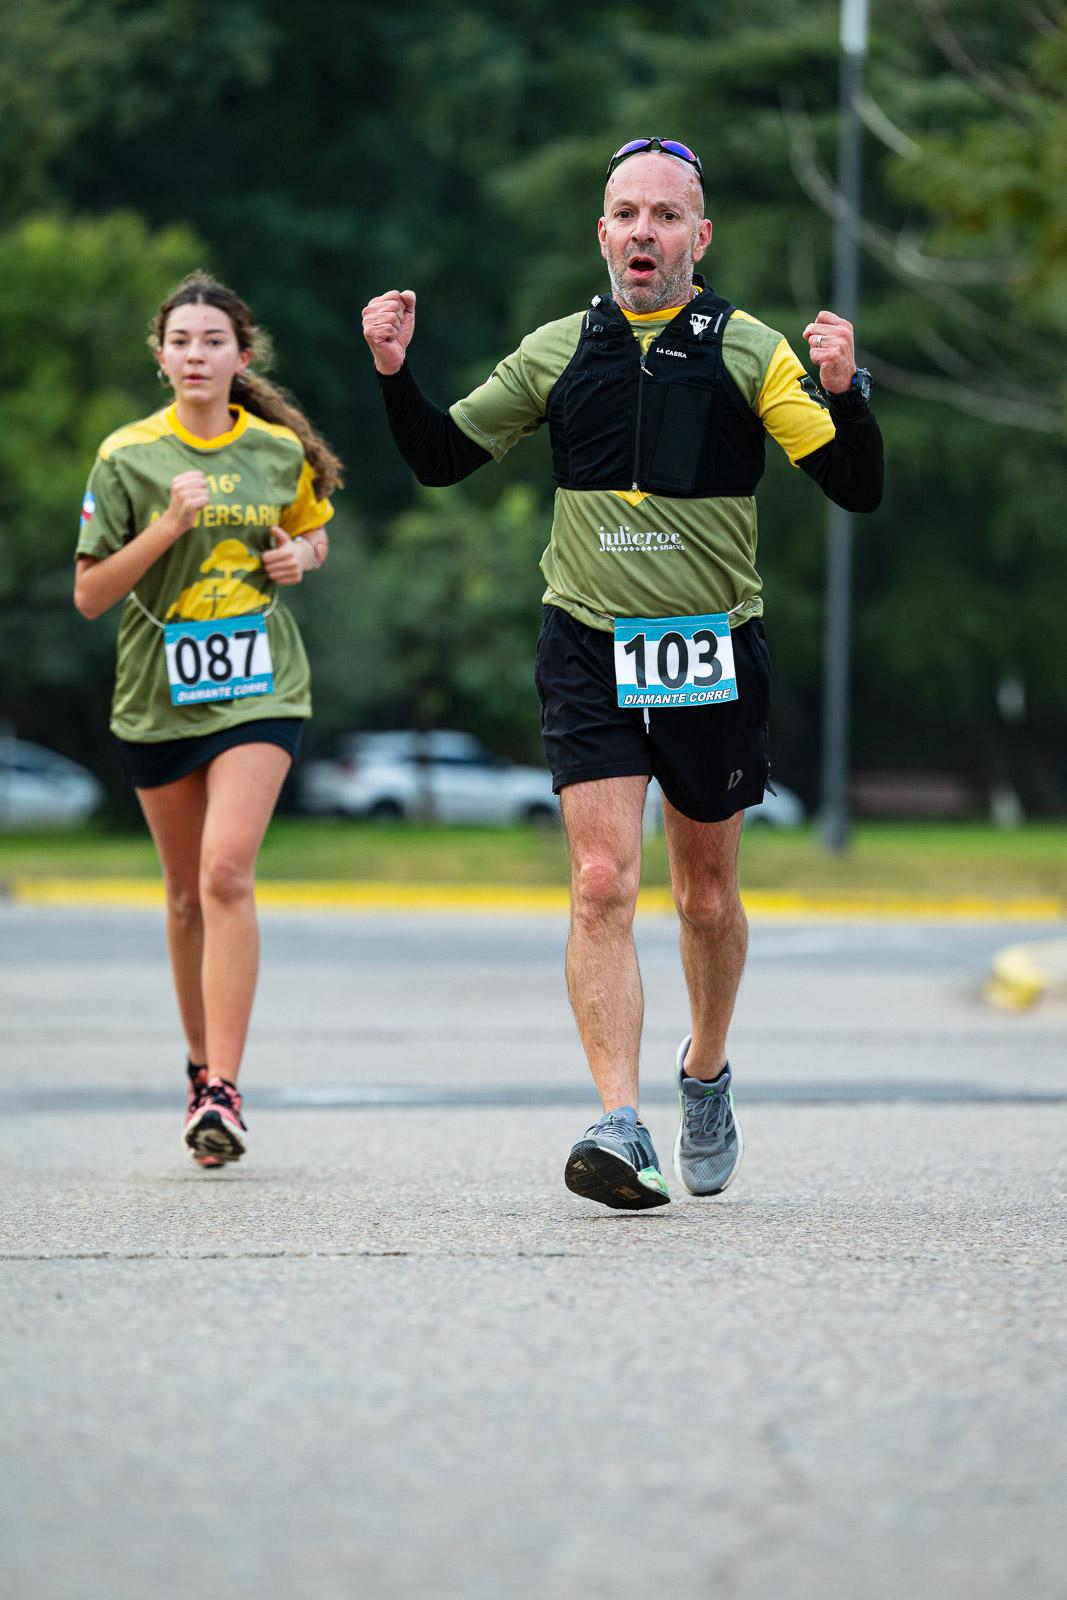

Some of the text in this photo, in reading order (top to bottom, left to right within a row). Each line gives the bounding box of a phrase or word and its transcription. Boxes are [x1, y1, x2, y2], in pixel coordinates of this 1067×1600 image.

[665, 350, 687, 359] CABRA
[598, 525, 682, 552] julicroc
[175, 629, 257, 686] 087
[623, 628, 723, 690] 103
[177, 681, 269, 702] DIAMANTE CORRE
[623, 688, 731, 705] DIAMANTE CORRE
